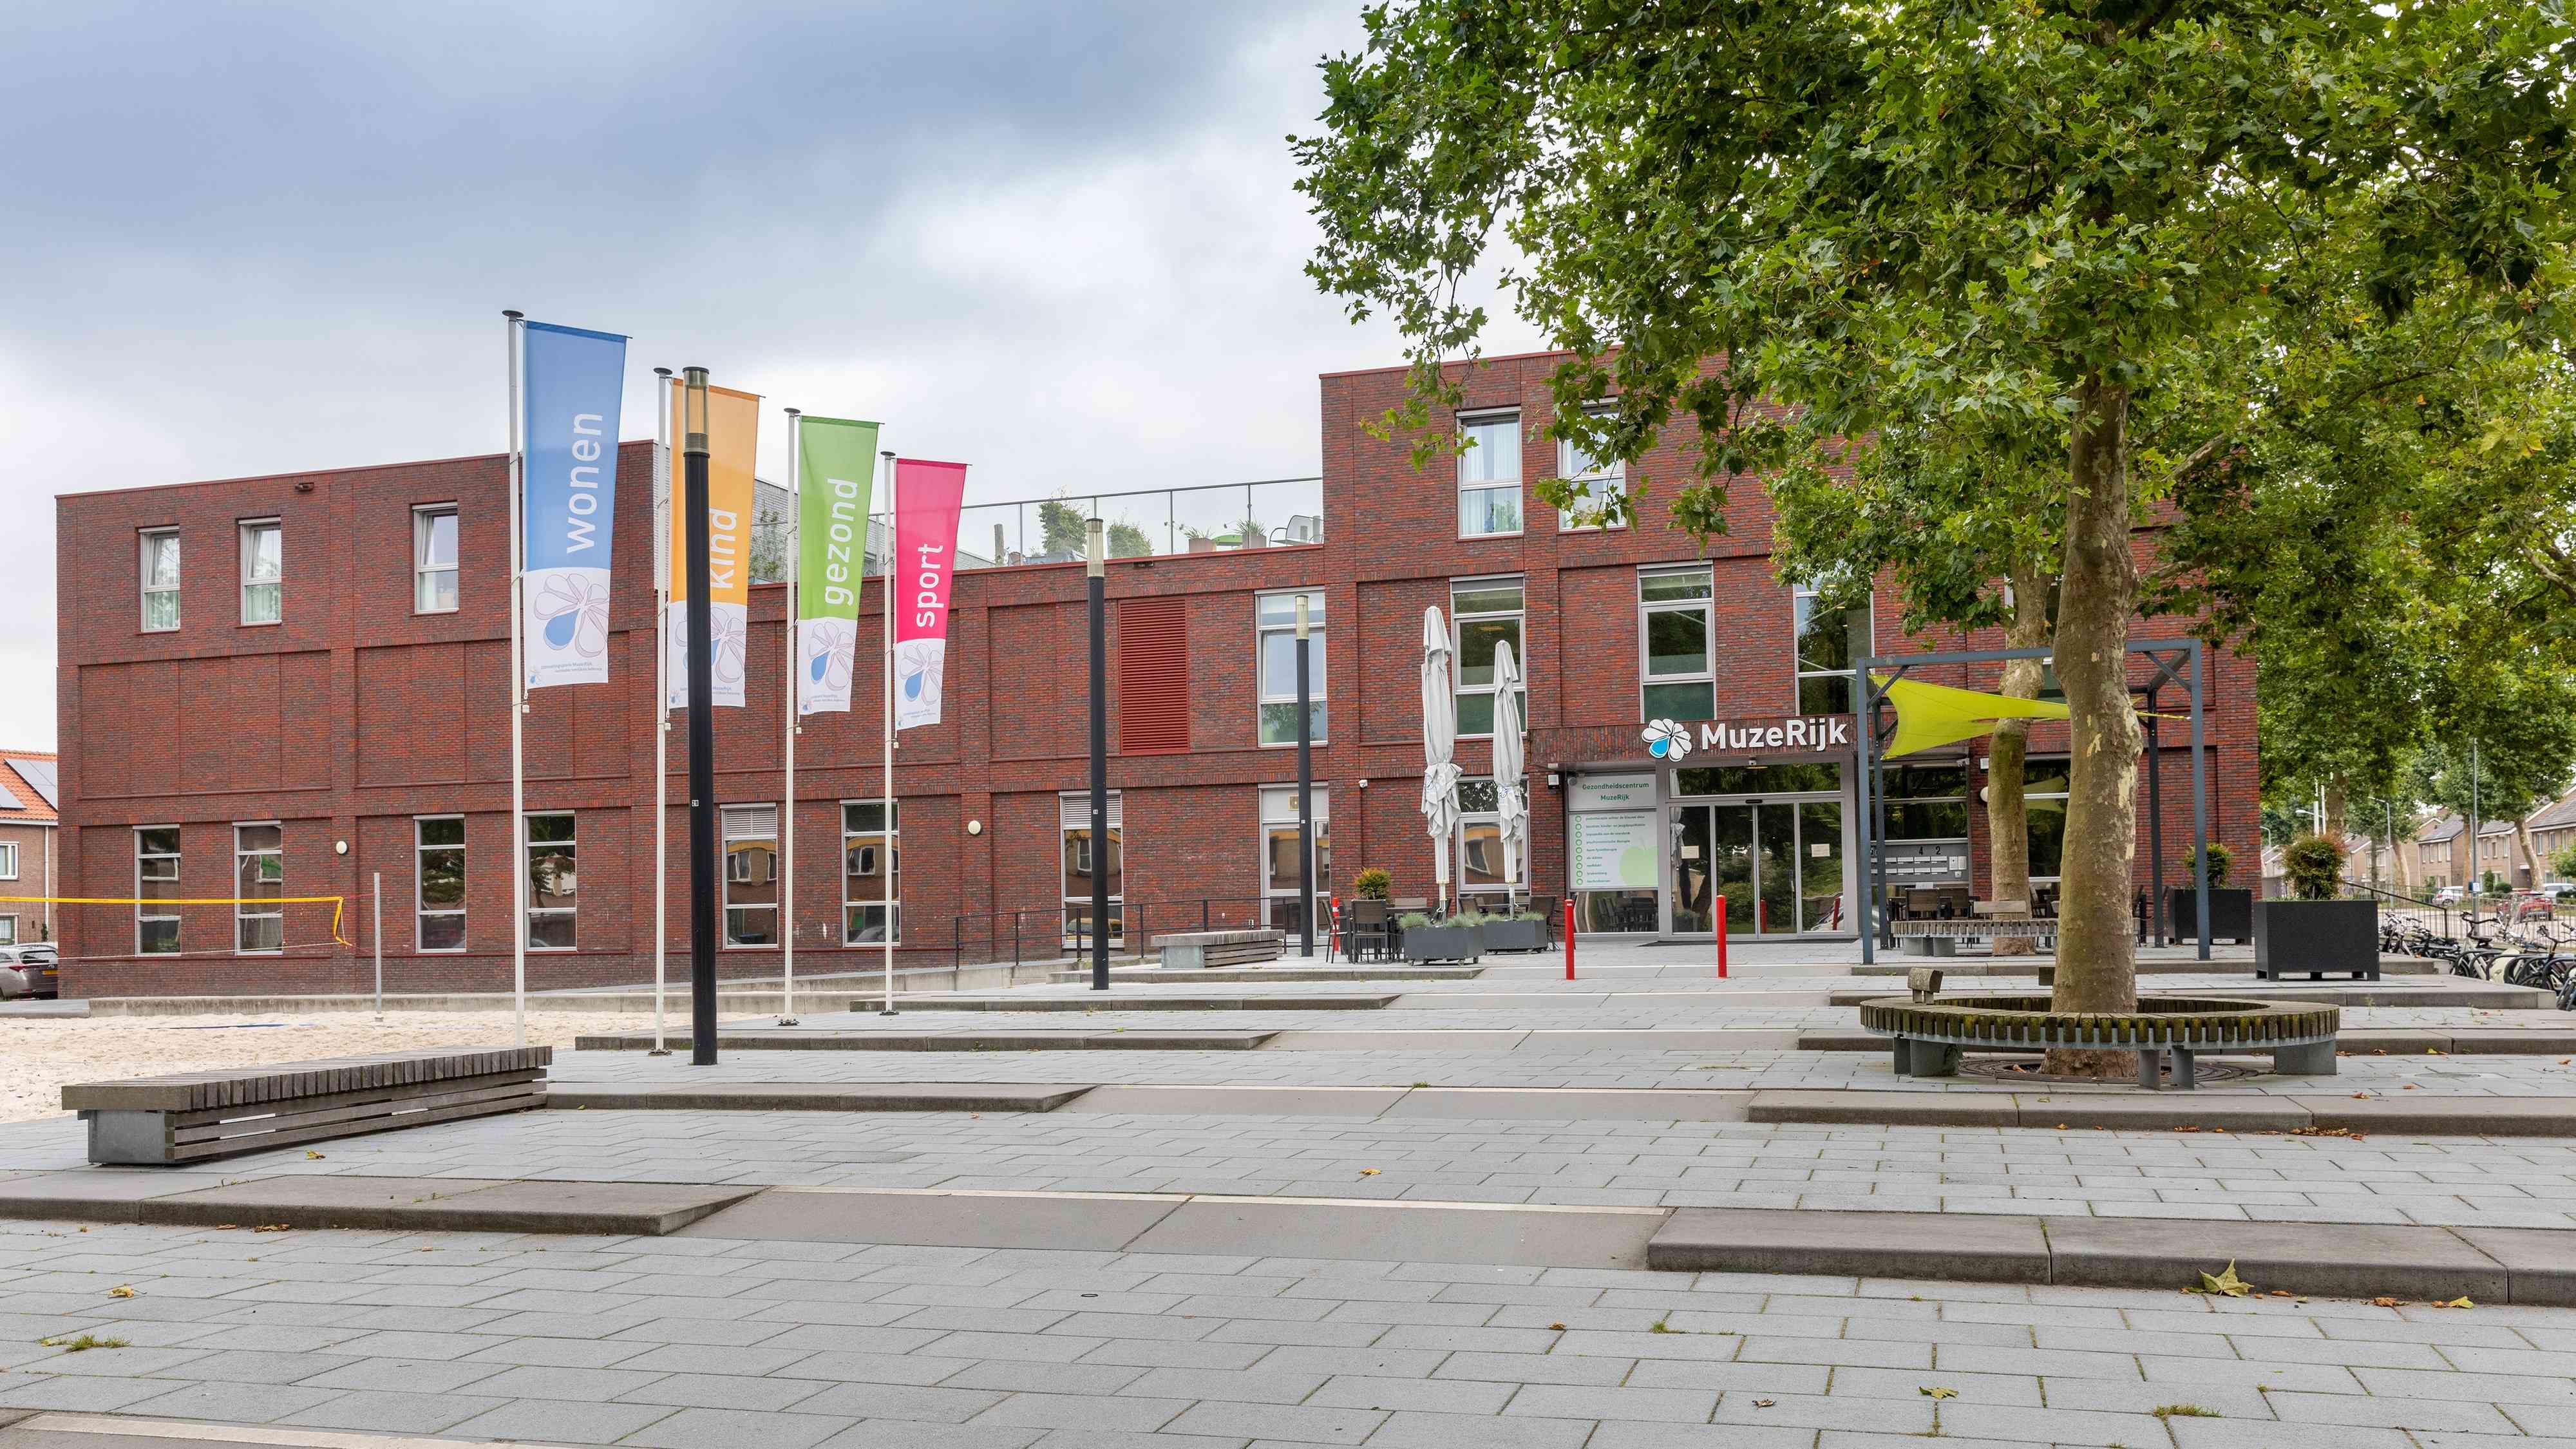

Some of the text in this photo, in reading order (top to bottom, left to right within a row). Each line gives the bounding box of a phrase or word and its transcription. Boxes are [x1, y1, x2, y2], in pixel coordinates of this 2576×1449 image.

[567, 412, 603, 553] wonen
[825, 478, 858, 606] gezond
[916, 544, 944, 628] sport
[1701, 717, 1848, 752] MuzeRijk
[1918, 846, 1941, 855] 4 2
